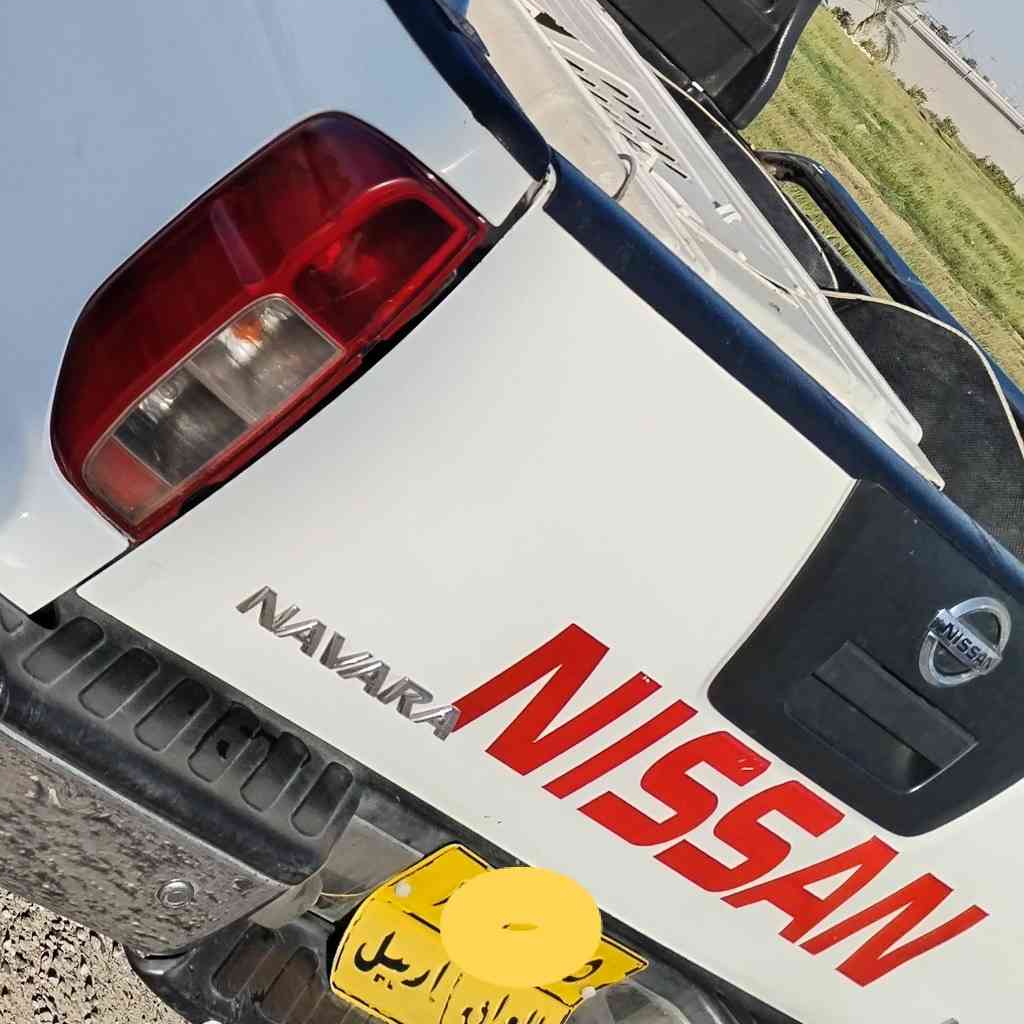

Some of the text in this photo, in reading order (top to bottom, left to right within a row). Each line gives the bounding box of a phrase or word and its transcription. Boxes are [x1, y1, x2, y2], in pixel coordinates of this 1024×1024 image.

[236, 585, 461, 741] NAVARA
[941, 622, 994, 670] NISSAN
[452, 623, 989, 987] NISSAN
